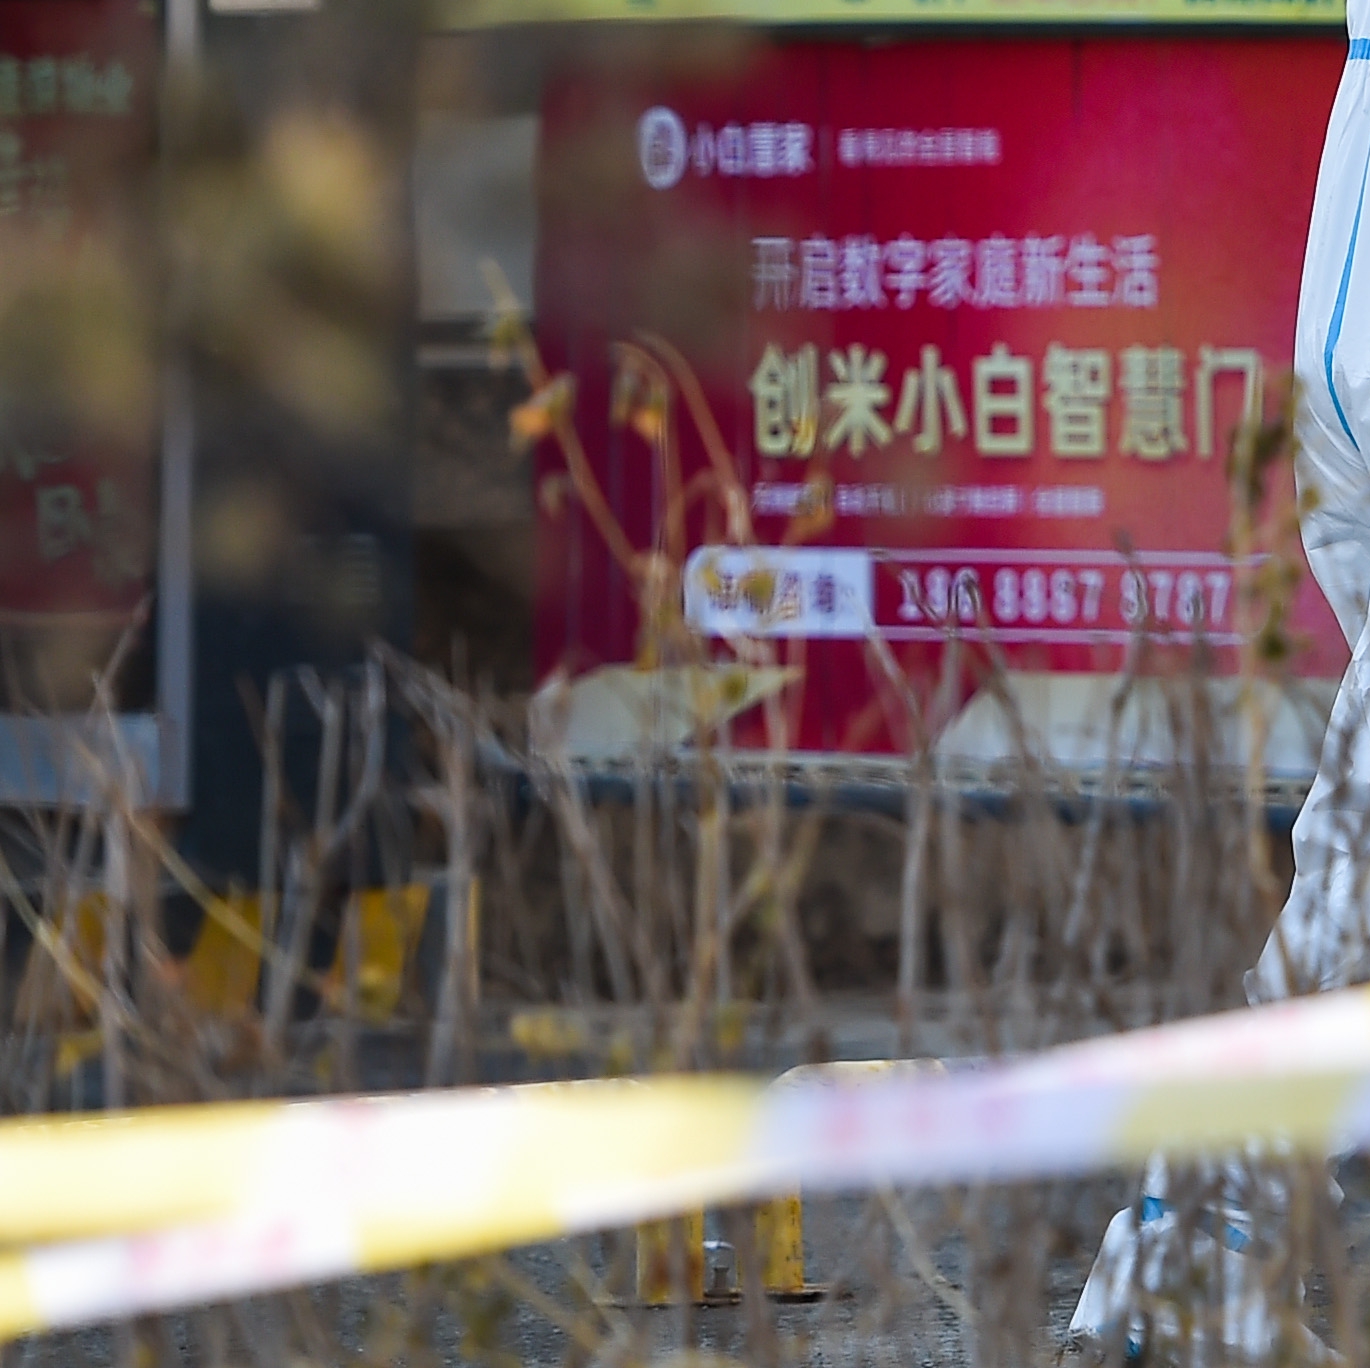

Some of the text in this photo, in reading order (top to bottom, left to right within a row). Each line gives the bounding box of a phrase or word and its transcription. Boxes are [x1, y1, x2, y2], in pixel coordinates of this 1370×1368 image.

[750, 232, 1161, 310] 开启数字家庭新生活
[752, 343, 1262, 460] 创米小白智慧门
